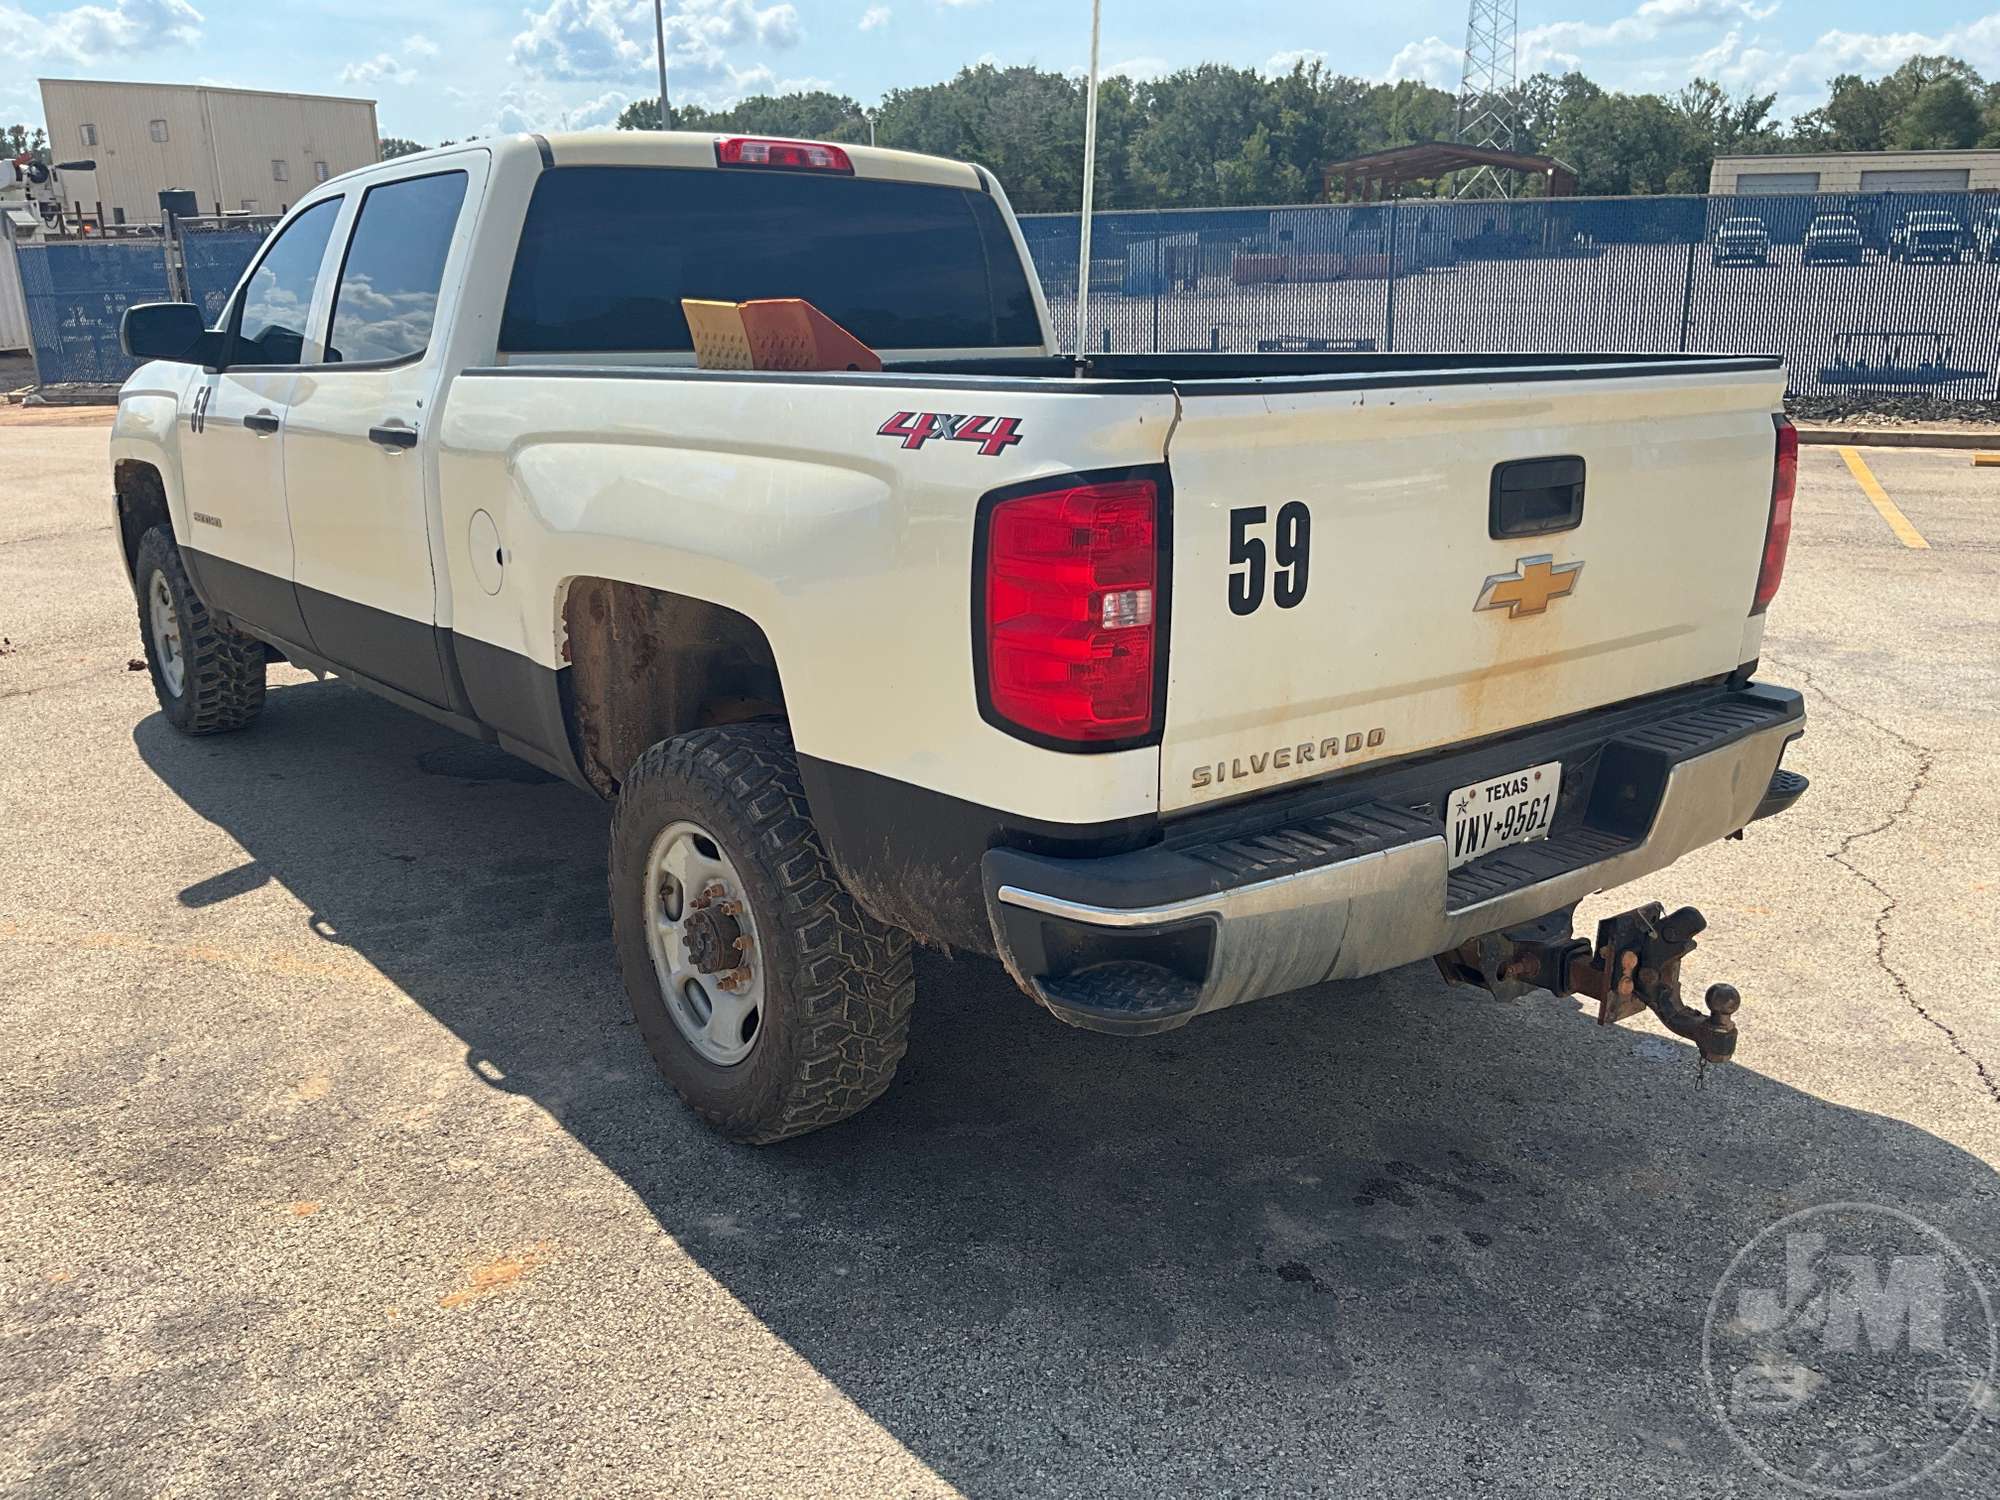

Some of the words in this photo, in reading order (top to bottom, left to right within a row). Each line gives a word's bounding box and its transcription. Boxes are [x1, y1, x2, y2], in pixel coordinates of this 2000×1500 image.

[1228, 500, 1311, 616] 59
[1191, 728, 1386, 789] SILVERADO
[1485, 776, 1528, 803] TEXAS
